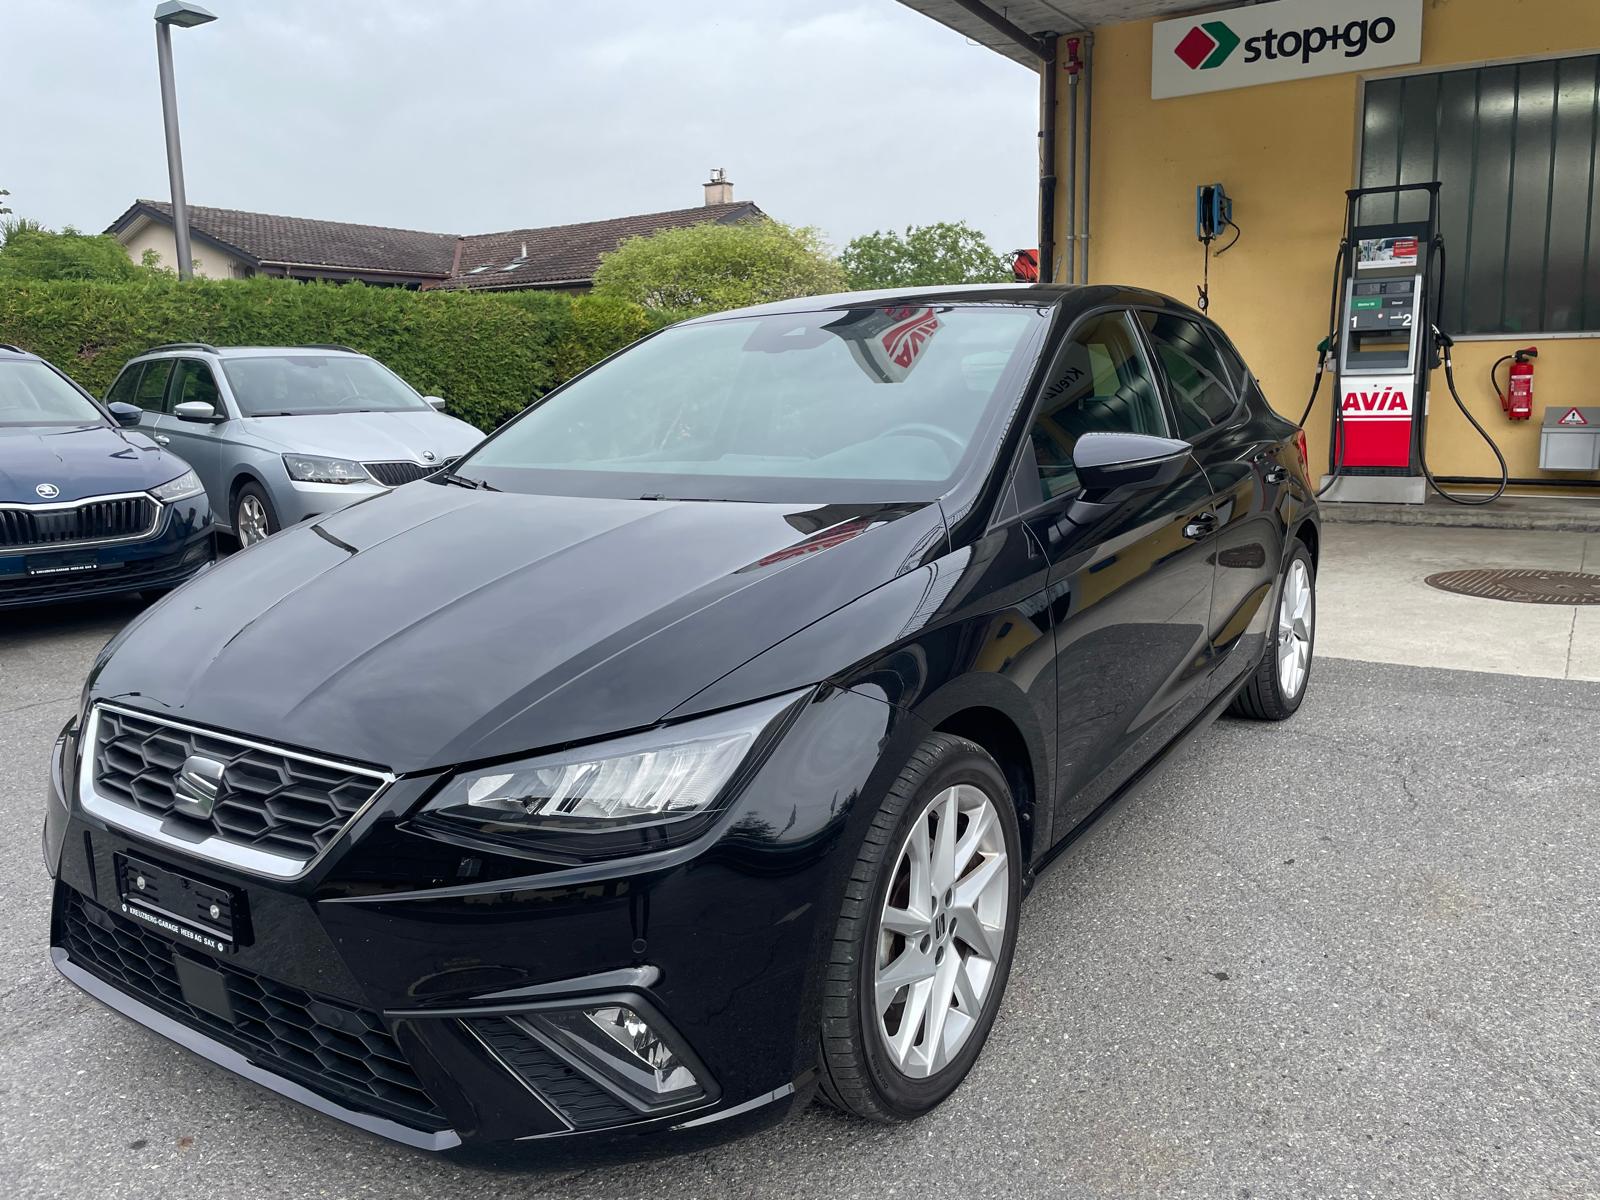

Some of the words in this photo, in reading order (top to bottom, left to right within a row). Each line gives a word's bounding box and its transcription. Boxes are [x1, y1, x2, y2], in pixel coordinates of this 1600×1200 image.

[1244, 16, 1396, 64] stop+go
[1350, 315, 1358, 329] 1
[1401, 313, 1412, 327] 2
[203, 937, 215, 948] SAX
